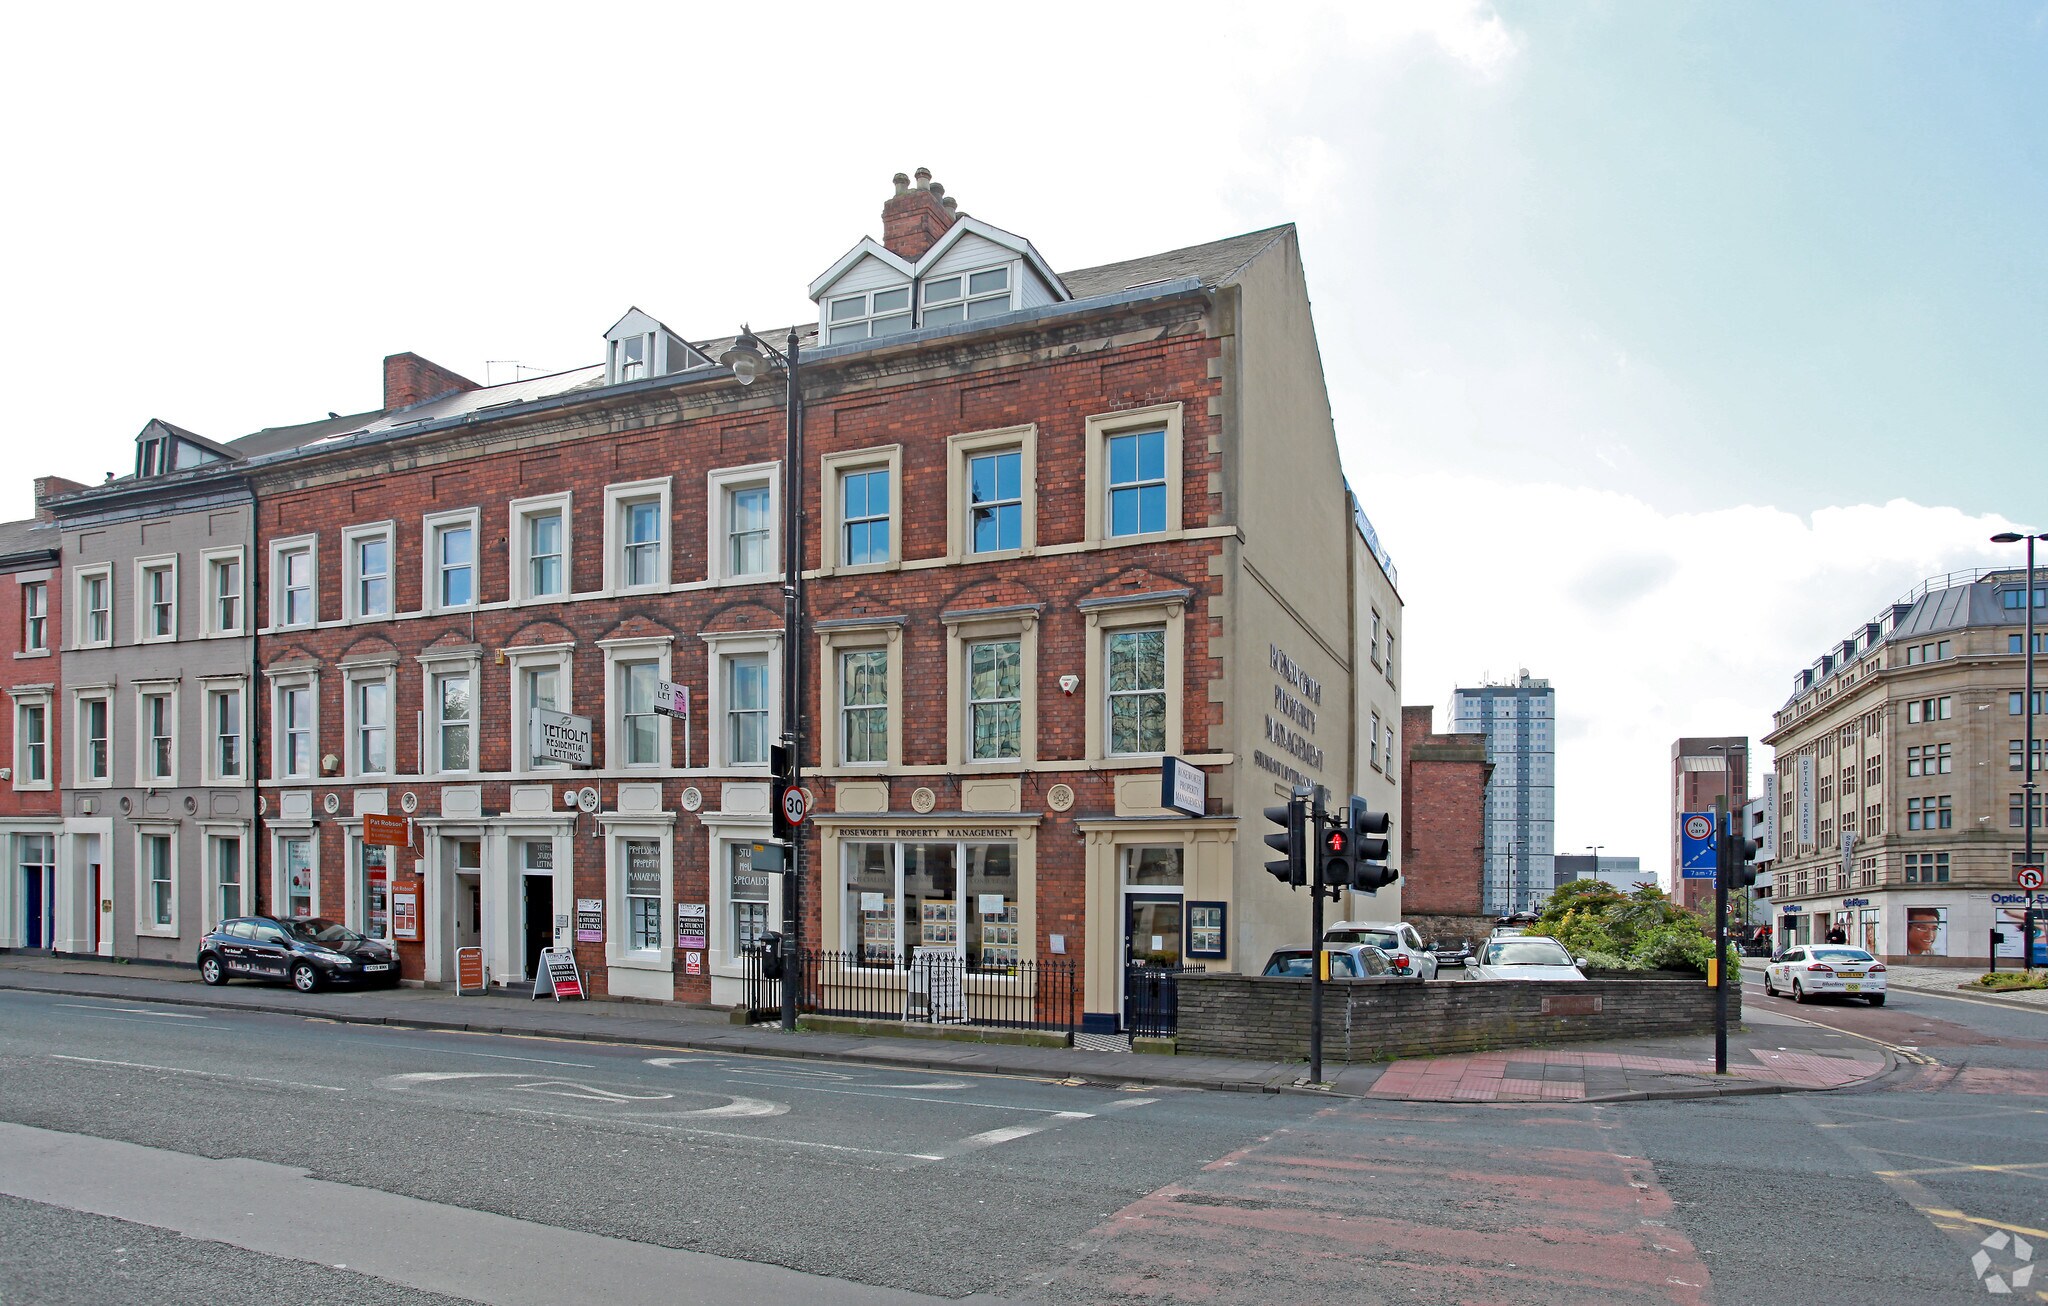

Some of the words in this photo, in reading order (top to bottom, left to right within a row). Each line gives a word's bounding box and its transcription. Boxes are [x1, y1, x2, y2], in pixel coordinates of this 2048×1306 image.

[660, 682, 669, 691] TO
[658, 691, 670, 700] LET
[543, 723, 589, 744] YETHOLM
[546, 738, 586, 753] RESIDENTIAL
[1265, 714, 1325, 772] MANAGEMENT
[549, 748, 583, 762] LETTINGS
[1178, 766, 1202, 785] ROSEWORTH
[1180, 780, 1200, 796] PROPERTY
[787, 797, 803, 815] 30
[1175, 791, 1203, 810] MANAGEMENT
[370, 818, 380, 826] Pat
[381, 820, 402, 828] Robson
[839, 829, 889, 837] ROSEWORTH
[896, 829, 940, 837] PROPERTY
[947, 829, 1013, 837] MANAGEMENT
[628, 846, 661, 855] PROFESSIONA
[633, 859, 660, 868] PROPERTY
[628, 872, 661, 881] MANAGEMEN
